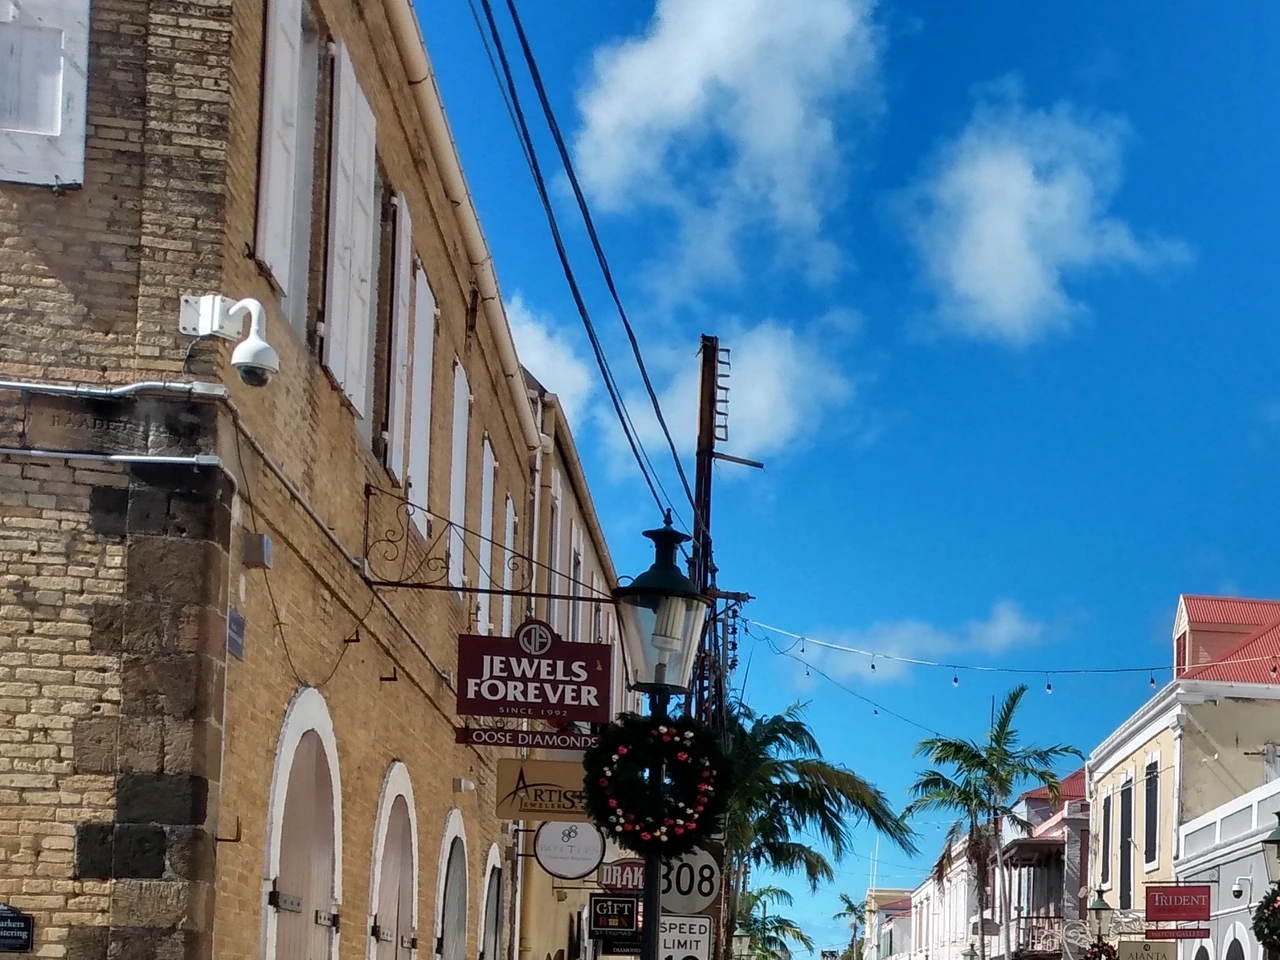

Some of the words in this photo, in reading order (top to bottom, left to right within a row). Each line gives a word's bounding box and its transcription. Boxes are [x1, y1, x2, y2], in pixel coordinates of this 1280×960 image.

[480, 655, 588, 682] JEWELS
[467, 678, 600, 706] FOREVER
[499, 706, 533, 715] SINCE
[541, 709, 568, 717] 1992
[518, 733, 598, 748] DIAMONDS
[1149, 892, 1208, 906] TRIDENT
[660, 922, 708, 935] SPEED
[664, 939, 701, 950] LIMIT
[1127, 952, 1168, 960] AJANTA
